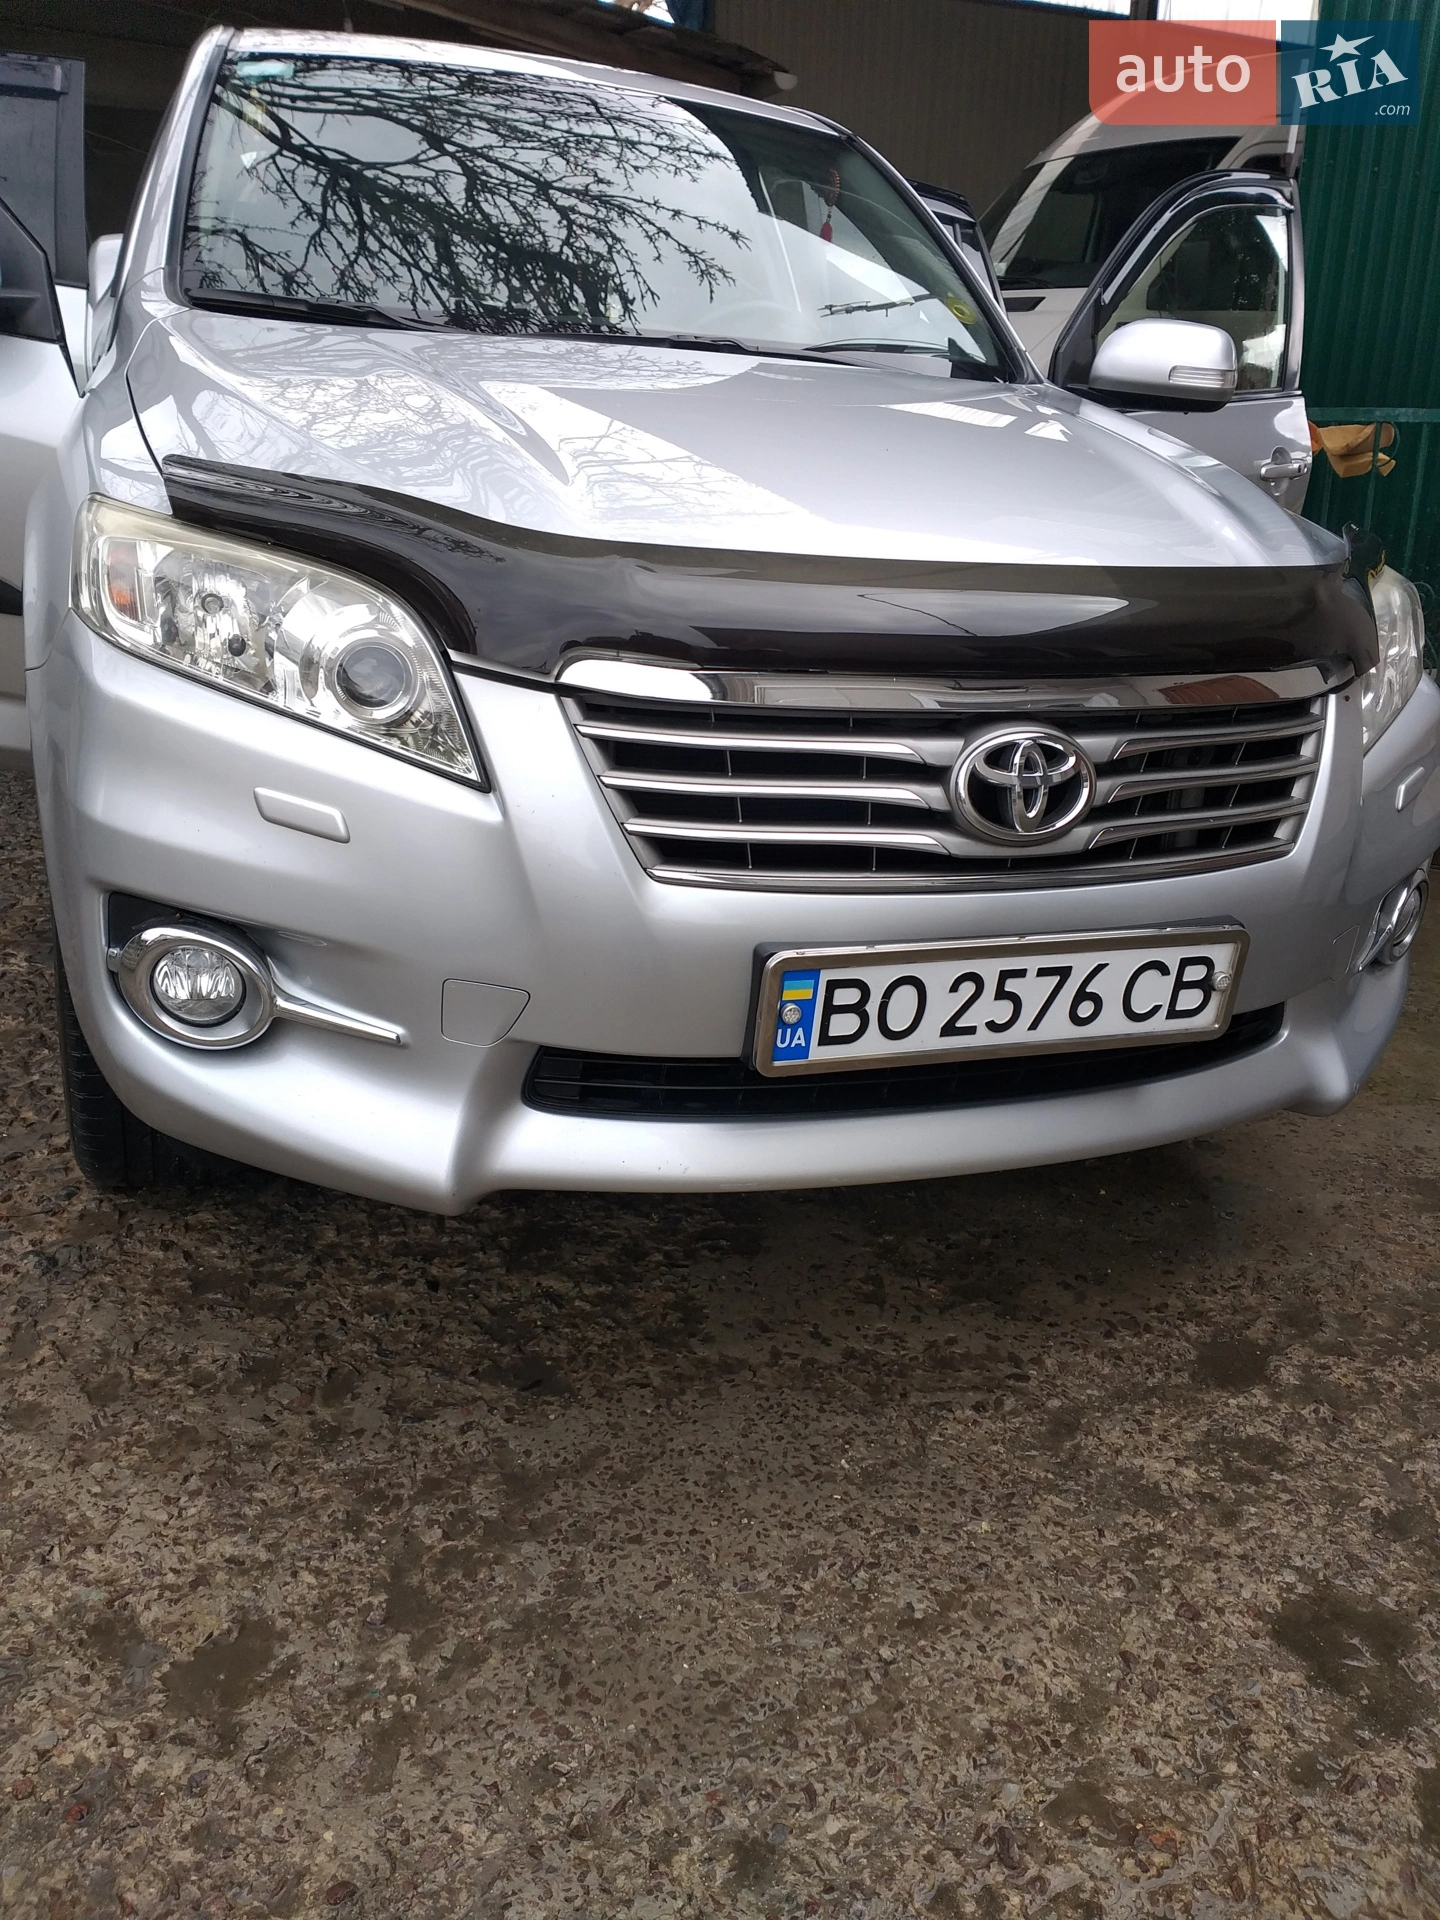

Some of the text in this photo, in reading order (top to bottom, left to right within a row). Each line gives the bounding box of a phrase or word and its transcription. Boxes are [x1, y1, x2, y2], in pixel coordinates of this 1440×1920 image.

[817, 956, 1216, 1046] BO 2576 CB
[776, 1027, 806, 1048] UA
